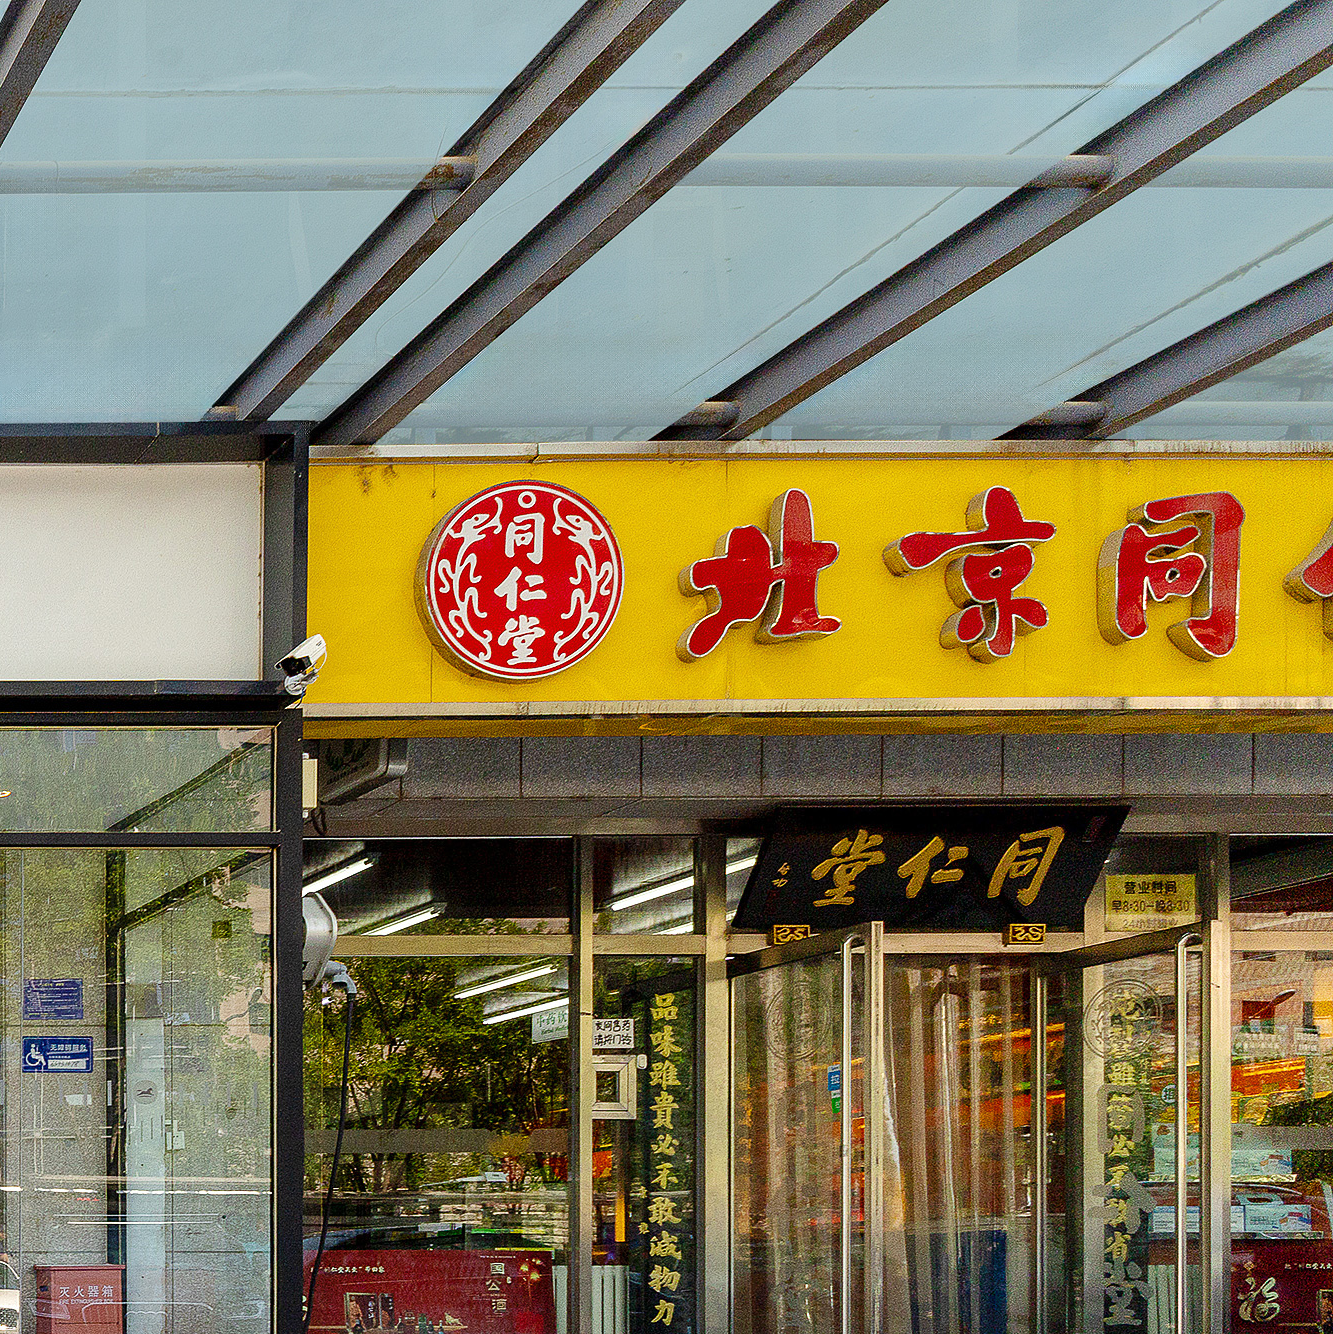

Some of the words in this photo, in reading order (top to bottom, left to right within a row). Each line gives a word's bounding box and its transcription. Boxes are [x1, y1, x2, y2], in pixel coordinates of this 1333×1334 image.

[494, 512, 548, 666] 同仁堂
[677, 485, 1333, 662] 北京同
[811, 826, 1065, 907] 同仁堂
[1124, 881, 1177, 895] 营业时间
[59, 1285, 114, 1297] 灭火器箱
